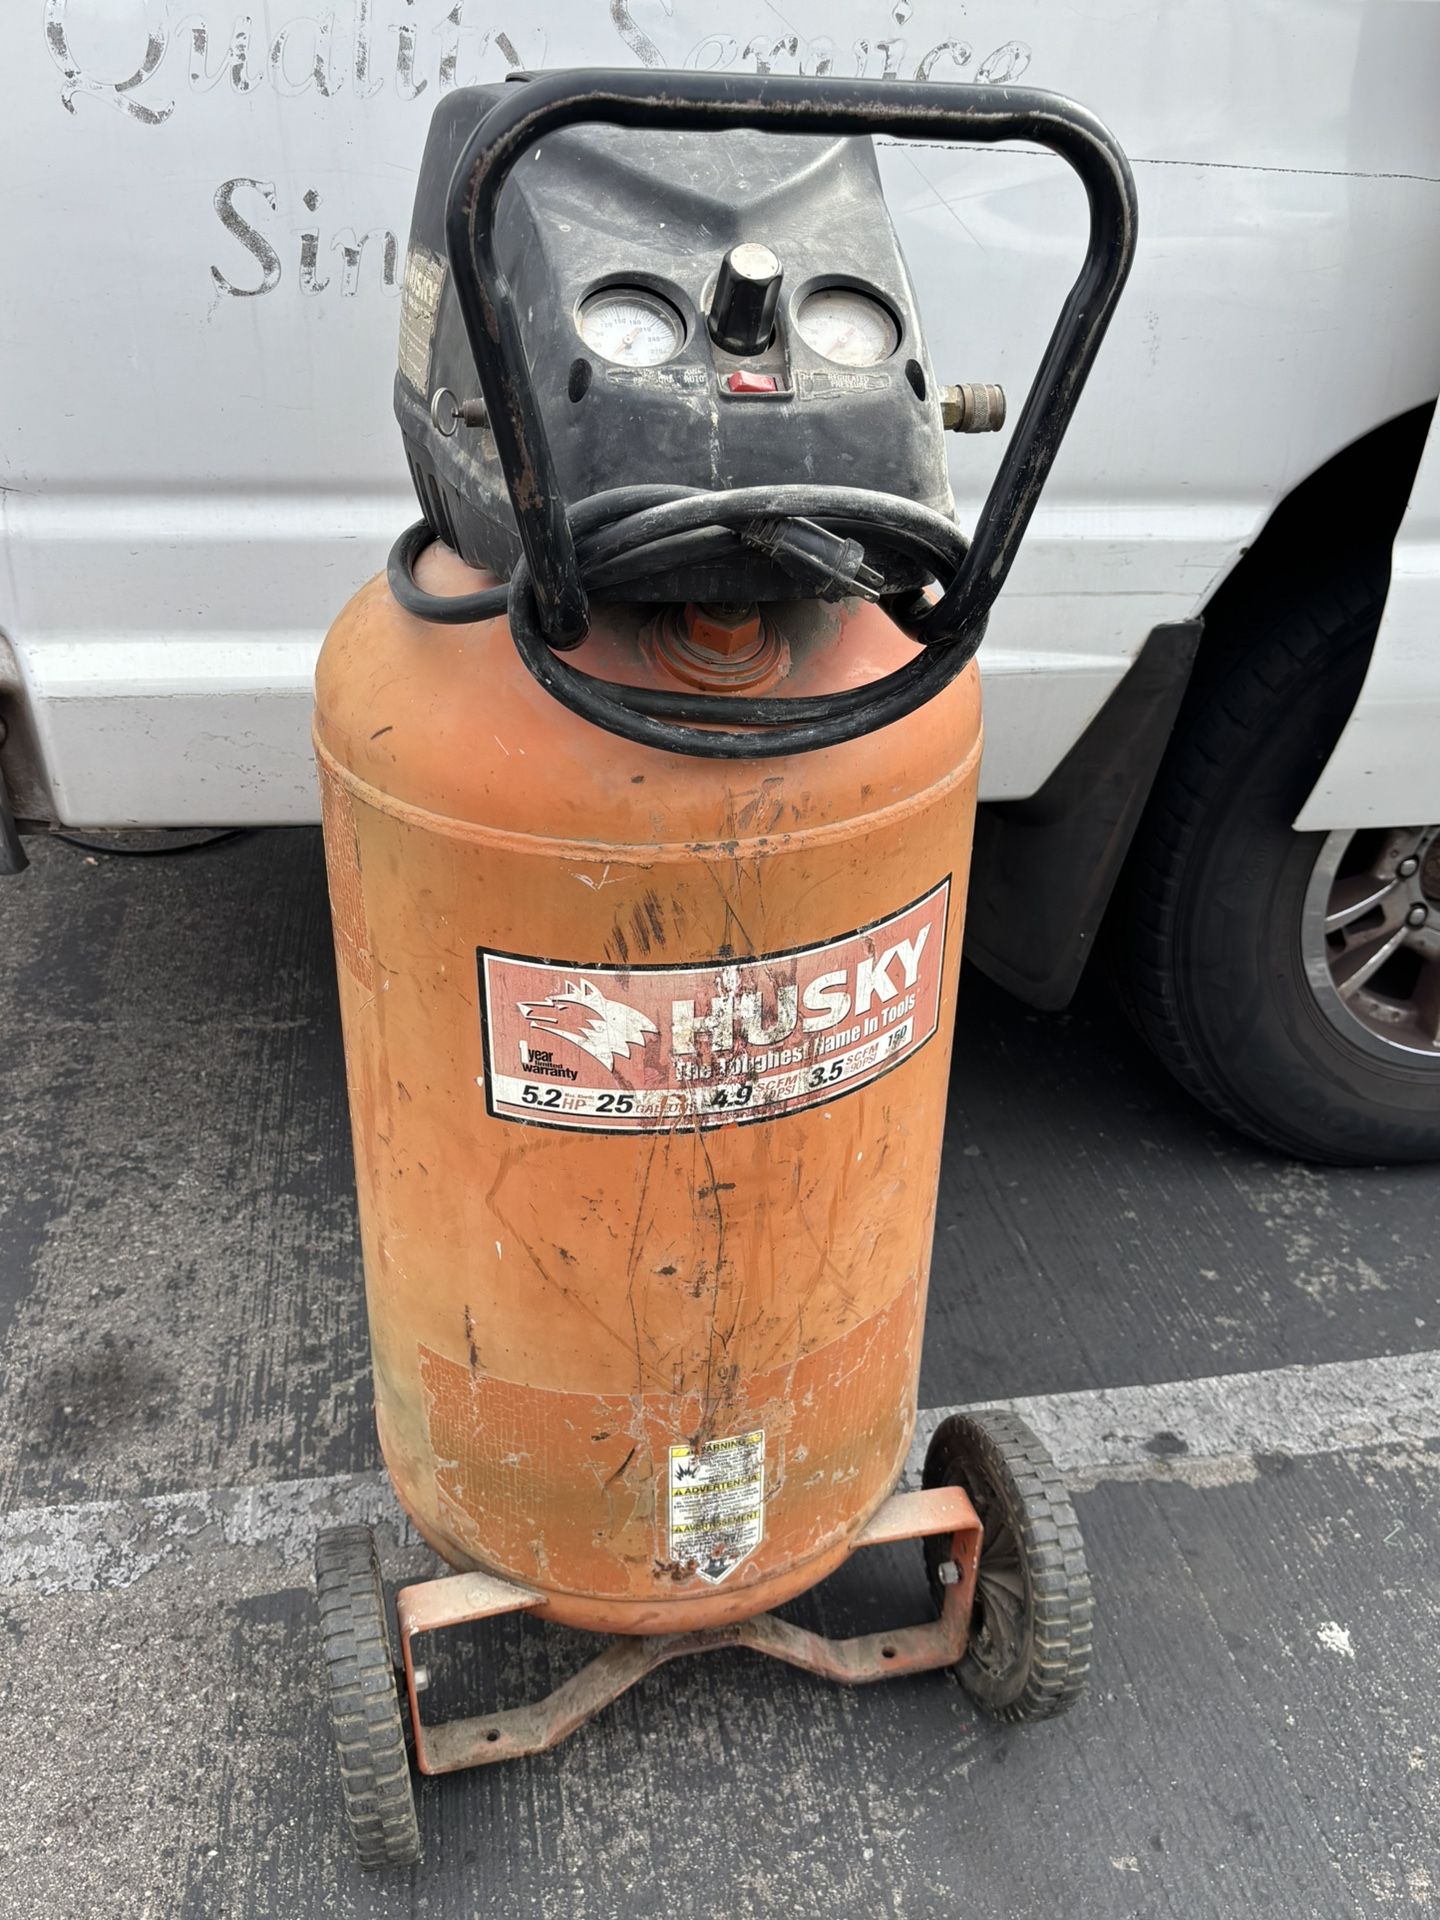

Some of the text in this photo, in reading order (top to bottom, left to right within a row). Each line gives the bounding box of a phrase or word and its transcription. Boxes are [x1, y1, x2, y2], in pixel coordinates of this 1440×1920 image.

[210, 177, 402, 298] Sin
[672, 921, 932, 1055] HUSKY
[674, 1059, 712, 1081] The
[717, 1041, 810, 1076] Toughest
[814, 1025, 861, 1056] Name
[863, 1016, 879, 1037] In
[881, 993, 916, 1027] Tools
[528, 1048, 553, 1063] year
[535, 1060, 563, 1069] limited
[522, 1062, 579, 1081] warranty
[711, 1085, 753, 1107] 4.9
[755, 1074, 798, 1092] SCFM
[809, 1059, 845, 1088] 3.5
[845, 1041, 880, 1065] SCFM
[521, 1084, 562, 1108] 5.2
[562, 1097, 587, 1111] HP
[595, 1093, 635, 1114] 25
[684, 1475, 758, 1495] ADVERTENCIA
